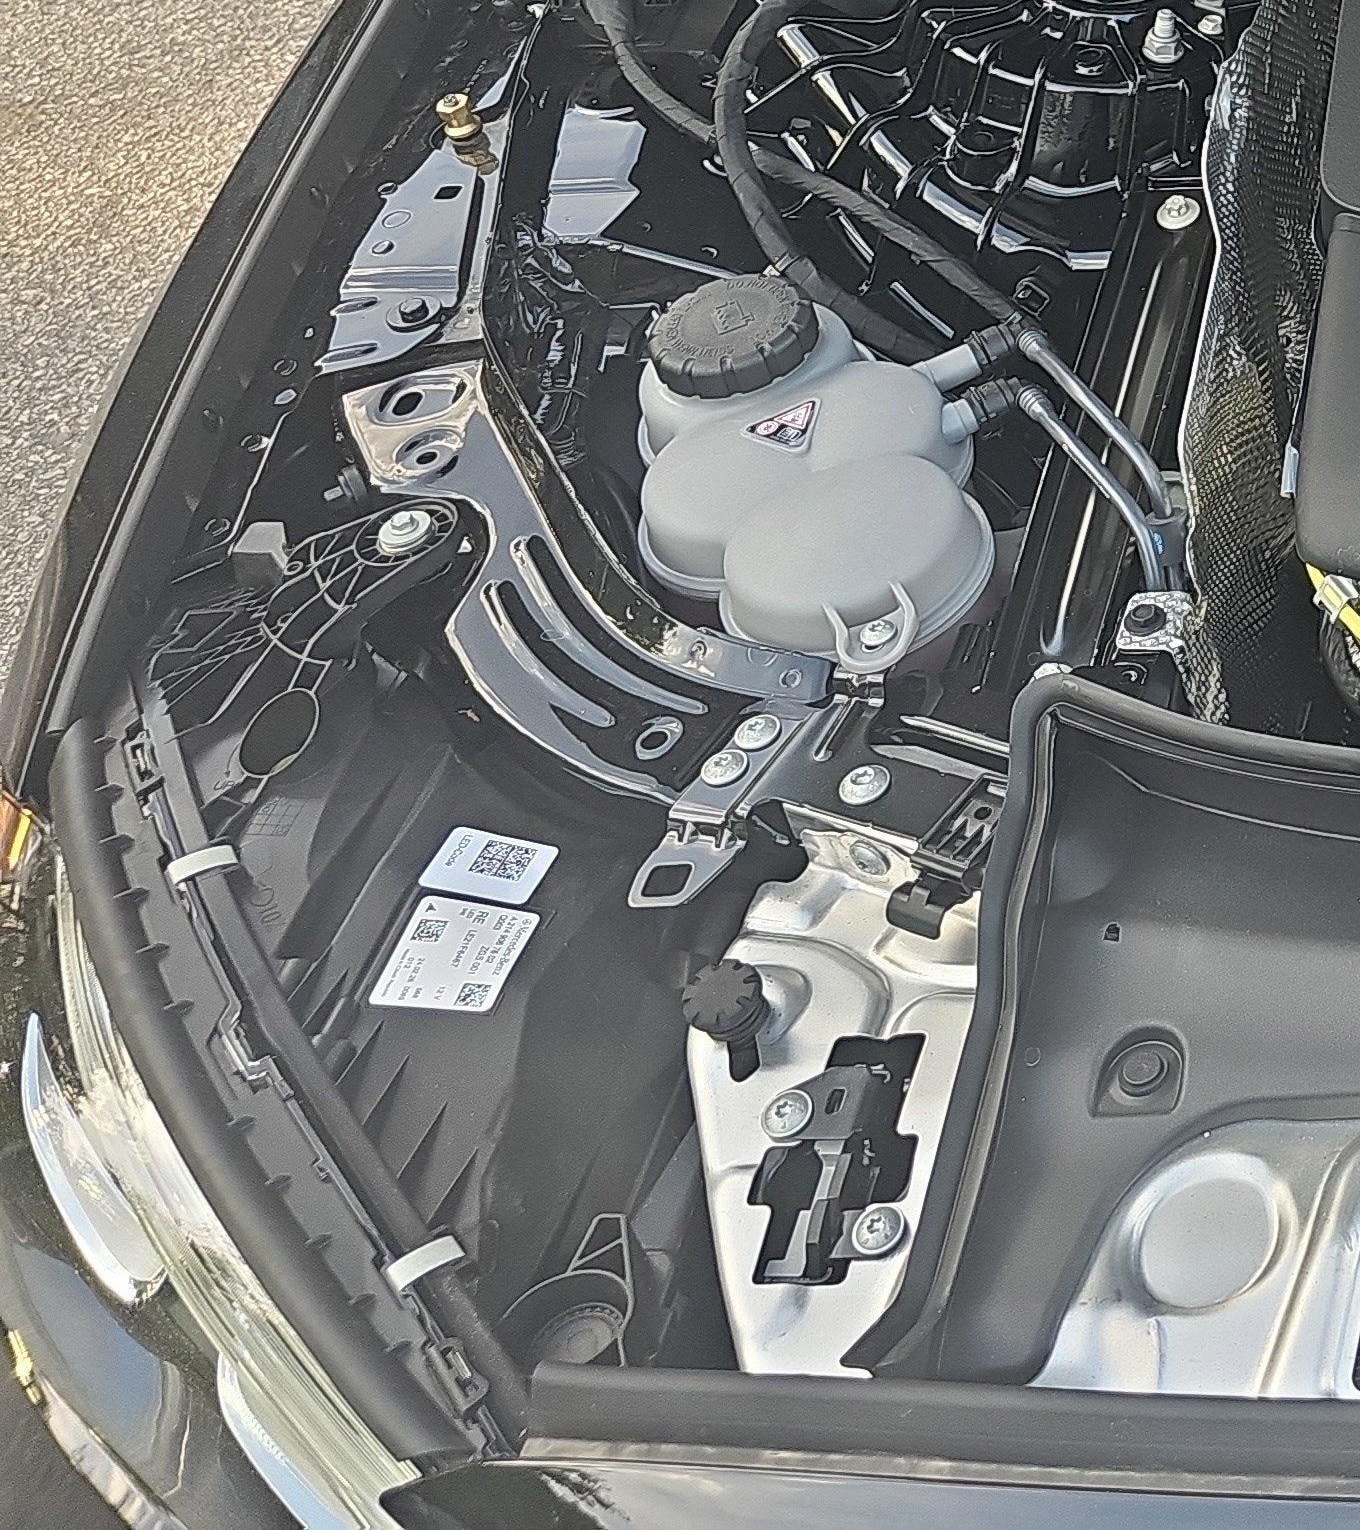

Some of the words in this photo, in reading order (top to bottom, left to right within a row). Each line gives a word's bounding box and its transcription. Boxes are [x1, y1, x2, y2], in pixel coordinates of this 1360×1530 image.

[444, 833, 473, 867] LED-Code
[471, 910, 490, 925] RE
[502, 921, 515, 933] 214
[474, 945, 490, 960] ZGS
[491, 925, 529, 976] Mercedes-Benz
[466, 961, 481, 975] 001
[436, 985, 446, 993] 12
